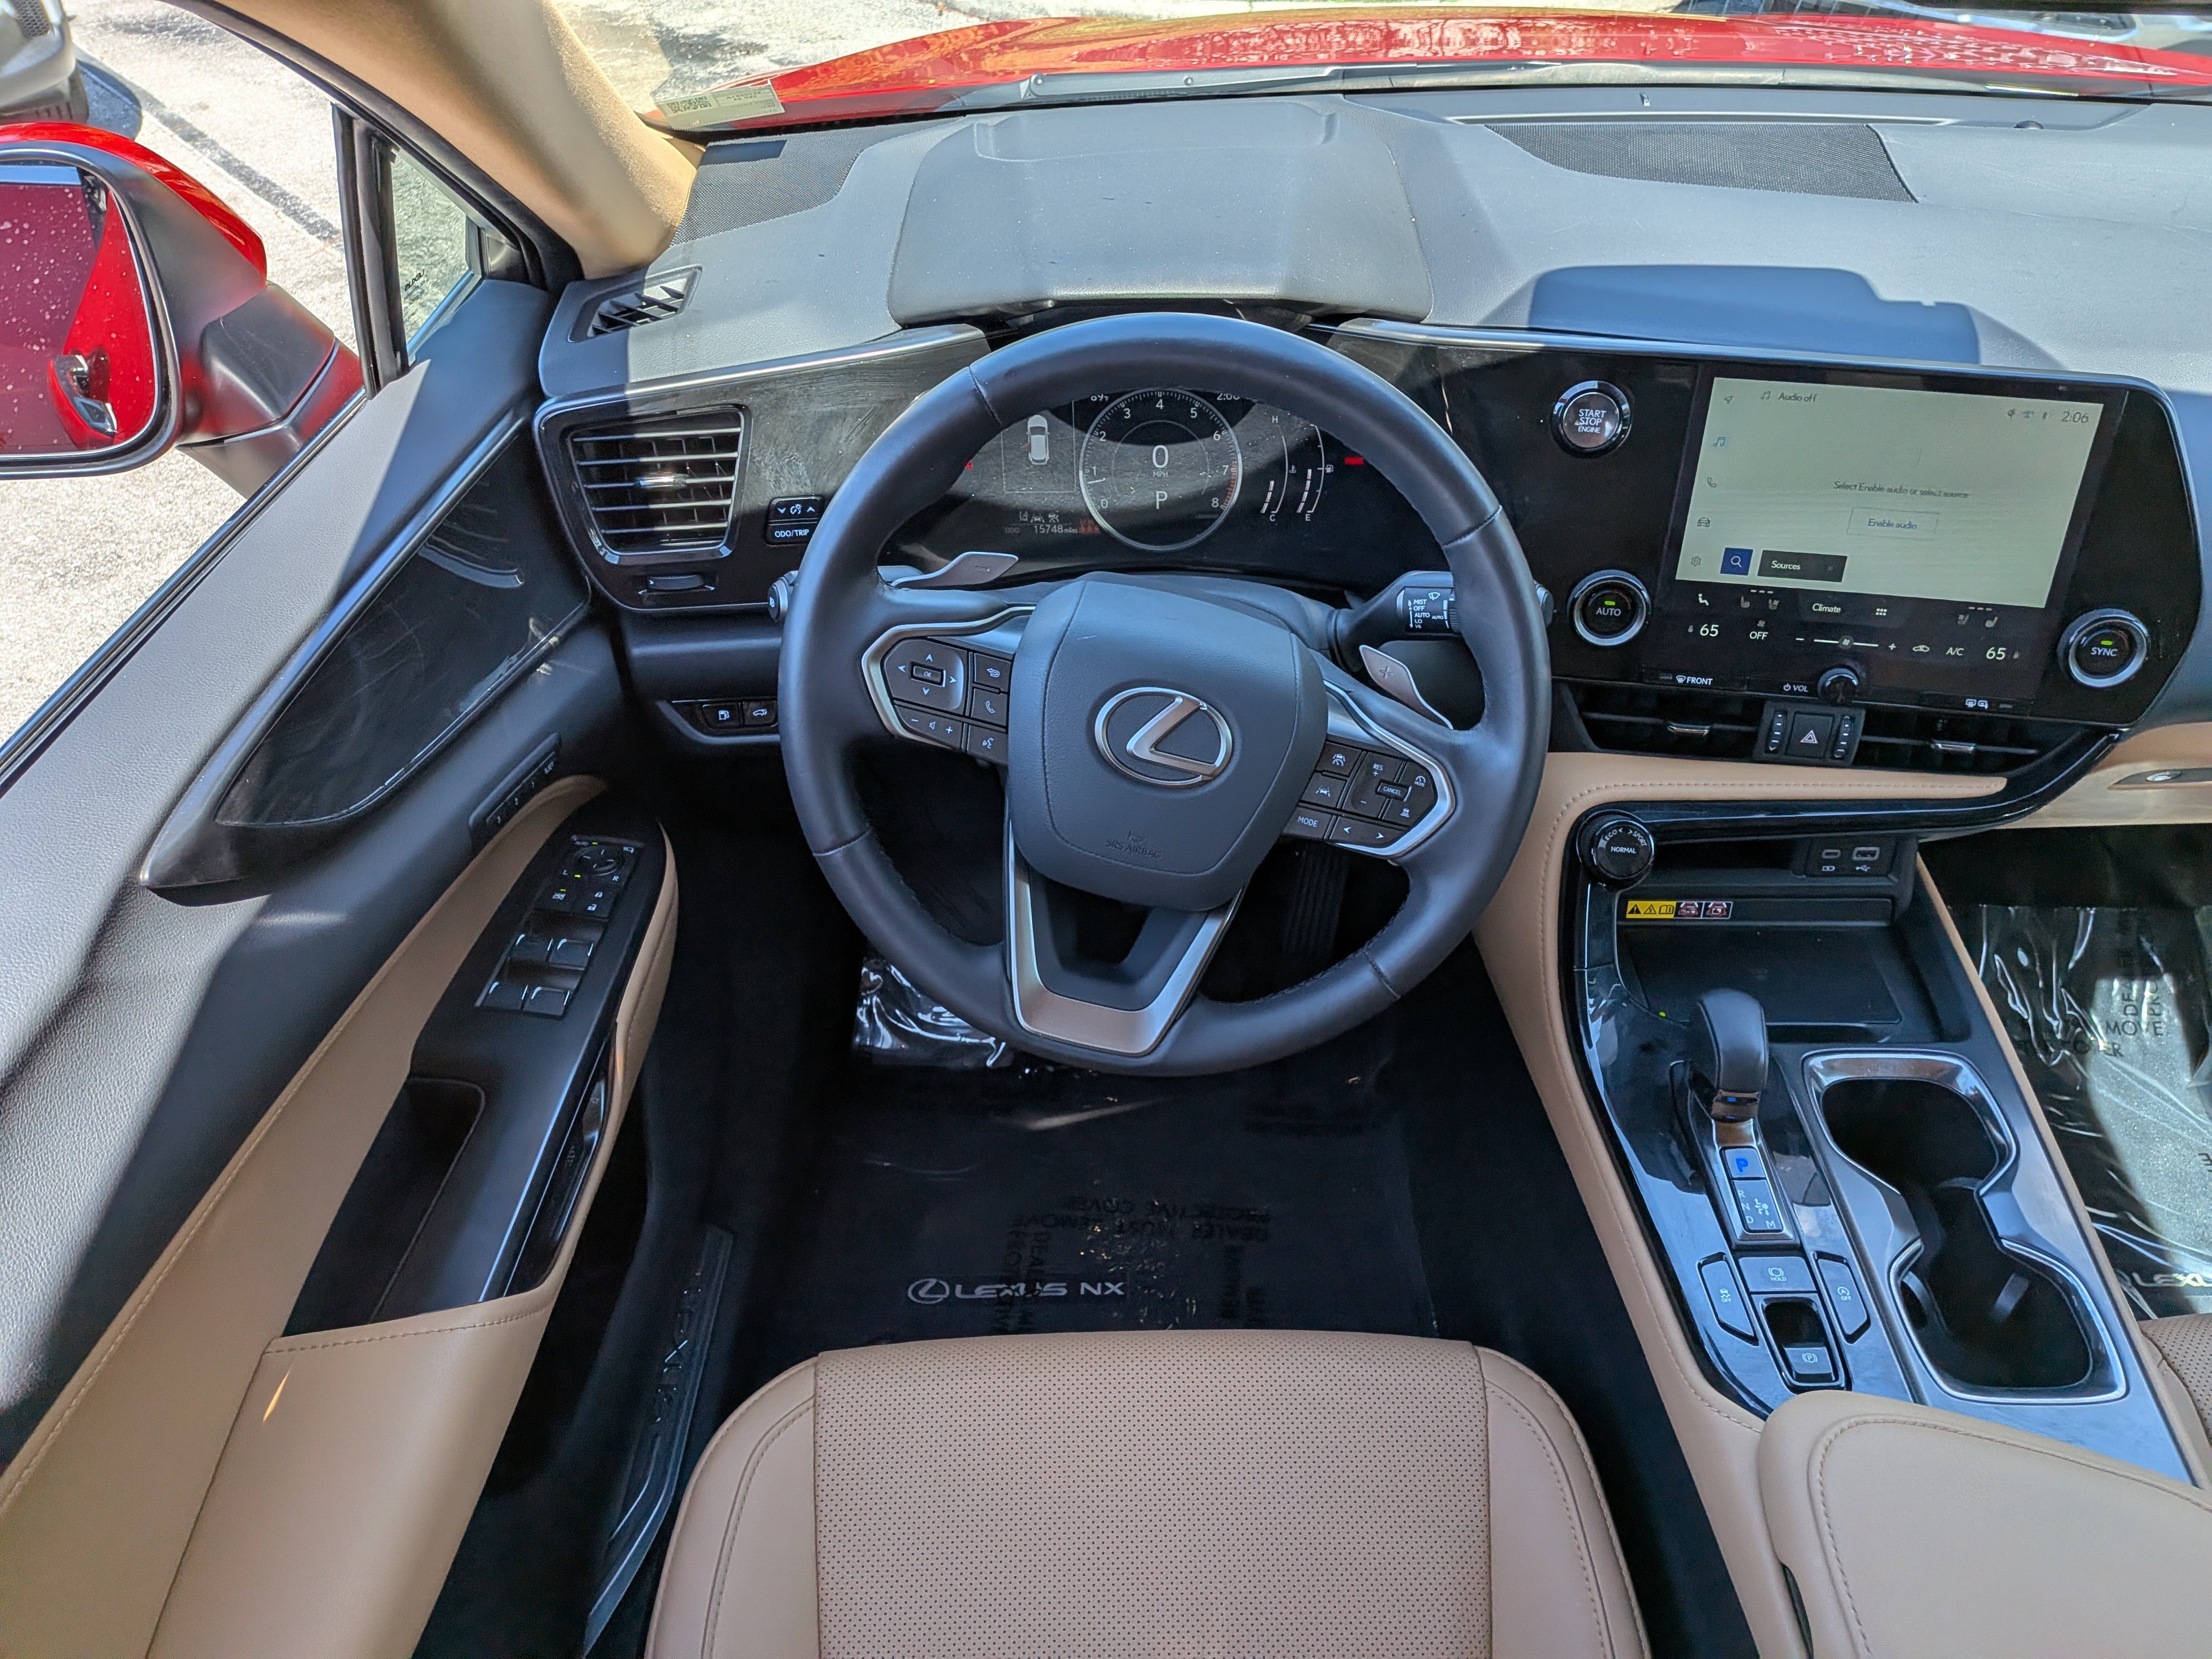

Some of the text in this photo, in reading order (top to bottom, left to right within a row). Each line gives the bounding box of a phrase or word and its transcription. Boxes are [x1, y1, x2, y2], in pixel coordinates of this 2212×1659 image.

[1777, 392, 1818, 403] Audio off
[1156, 399, 1164, 409] 4
[1124, 408, 1131, 419] 3
[1191, 408, 1198, 418] 5
[1579, 409, 1606, 418] START
[2062, 411, 2089, 424] 2:06
[1579, 417, 1603, 426] STOP
[1099, 431, 1107, 441] 2
[1213, 430, 1221, 441] 6
[1152, 445, 1169, 468] 0
[1092, 466, 1097, 476] 1
[1222, 465, 1229, 476] 7
[1834, 481, 1858, 491] Select
[1858, 482, 1885, 493] Enable
[1886, 486, 1908, 494] audio
[1919, 488, 1943, 497] select
[1100, 498, 1108, 509] 0
[1156, 491, 1168, 509] P
[1211, 497, 1219, 508] 8
[1034, 524, 1063, 534] 15748
[1867, 518, 1917, 529] Enable audio
[774, 529, 810, 538] ODO/TRIP
[1771, 560, 1801, 570] Sources
[1596, 607, 1621, 617] AUTO
[1812, 603, 1841, 613] Climate
[1699, 623, 1719, 637] 65
[1749, 631, 1768, 640] OFF
[1945, 646, 1965, 656] A/C
[1985, 646, 2007, 660] 65
[2090, 646, 2119, 658] SYNC
[1686, 676, 1713, 686] FRONT
[1792, 685, 1809, 693] VOL
[1383, 786, 1401, 796] CANCEL
[1297, 816, 1319, 828] MODE
[1605, 829, 1618, 841] ECO
[1632, 831, 1648, 847] SPORT
[1735, 1158, 1749, 1173] P
[1738, 1190, 1745, 1198] R
[1765, 1220, 1776, 1229] M
[1080, 1282, 1125, 1296] NX
